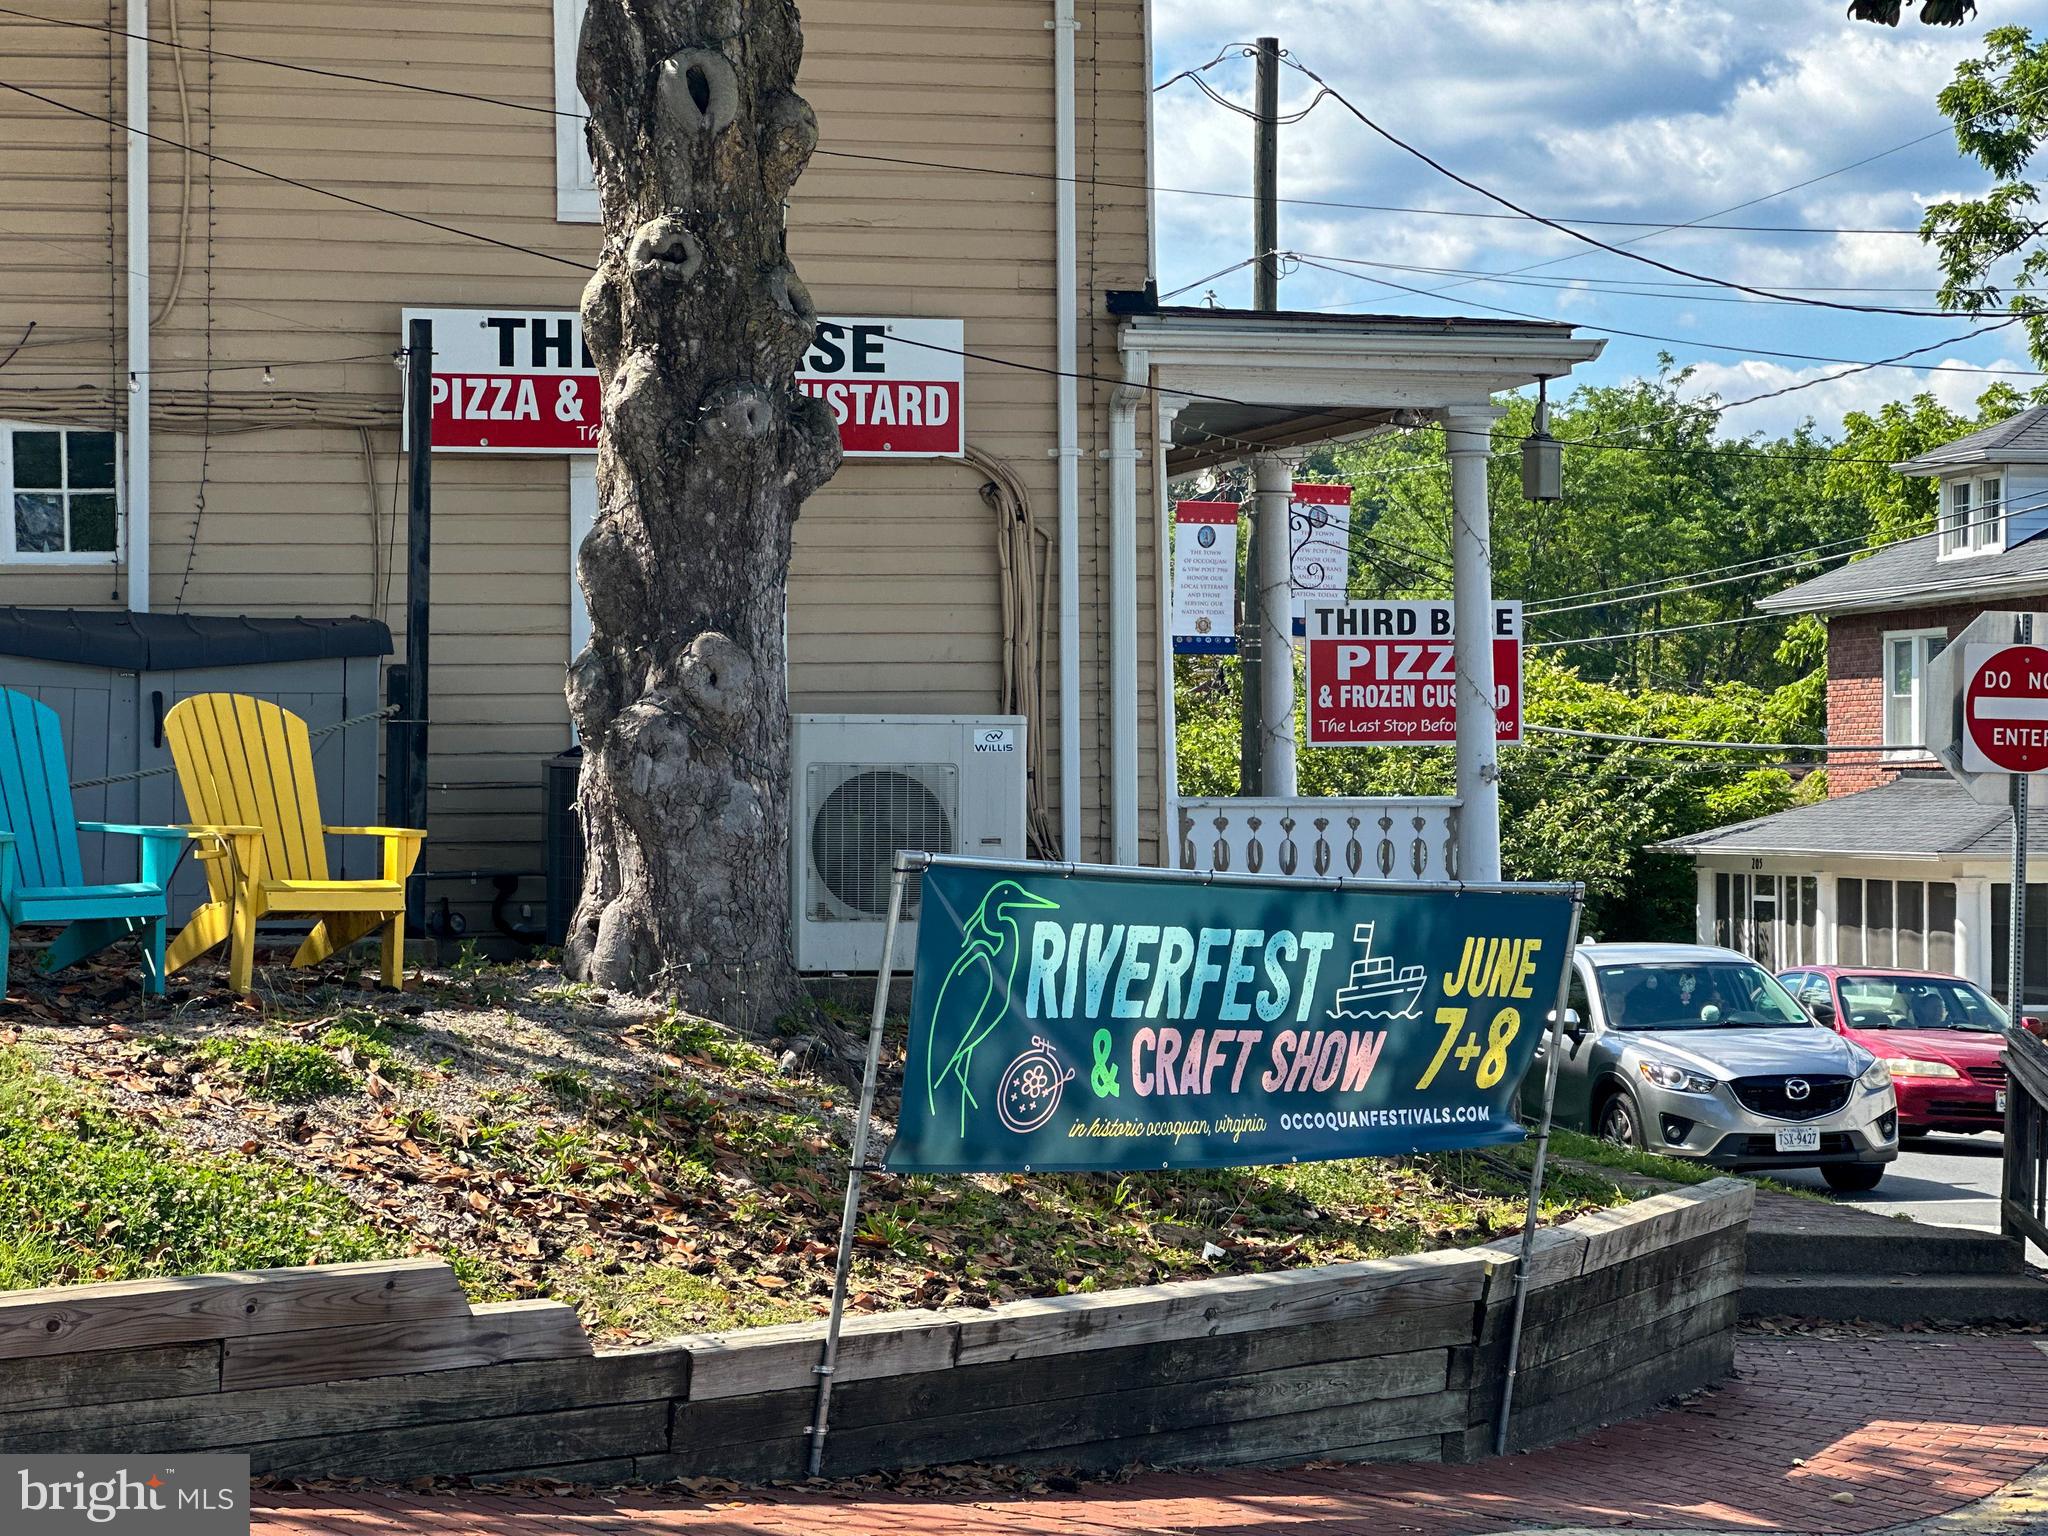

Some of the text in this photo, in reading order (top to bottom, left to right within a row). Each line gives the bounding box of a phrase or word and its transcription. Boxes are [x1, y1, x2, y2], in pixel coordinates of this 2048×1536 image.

[432, 378, 584, 421] PIZZA &
[799, 383, 949, 426] STARD
[1315, 609, 1513, 635] THIRD BE
[1337, 645, 1456, 680] PIZZ
[1985, 671, 2011, 689] DO
[1318, 685, 1333, 708] &
[1340, 685, 1415, 708] FROZEN
[1319, 718, 1345, 733] The
[1350, 720, 1380, 733] Last
[1384, 719, 1417, 736] Stop
[1026, 921, 1335, 1022] RIVERFEST
[1443, 936, 1542, 999] JUNE
[1091, 1027, 1388, 1098] & CRAFT SHOW
[1415, 1007, 1521, 1090] 7+8
[1068, 1113, 1267, 1146] in historic occoquan, virginia
[1280, 1106, 1490, 1132] OCCOQUANFESTIVALS.COM
